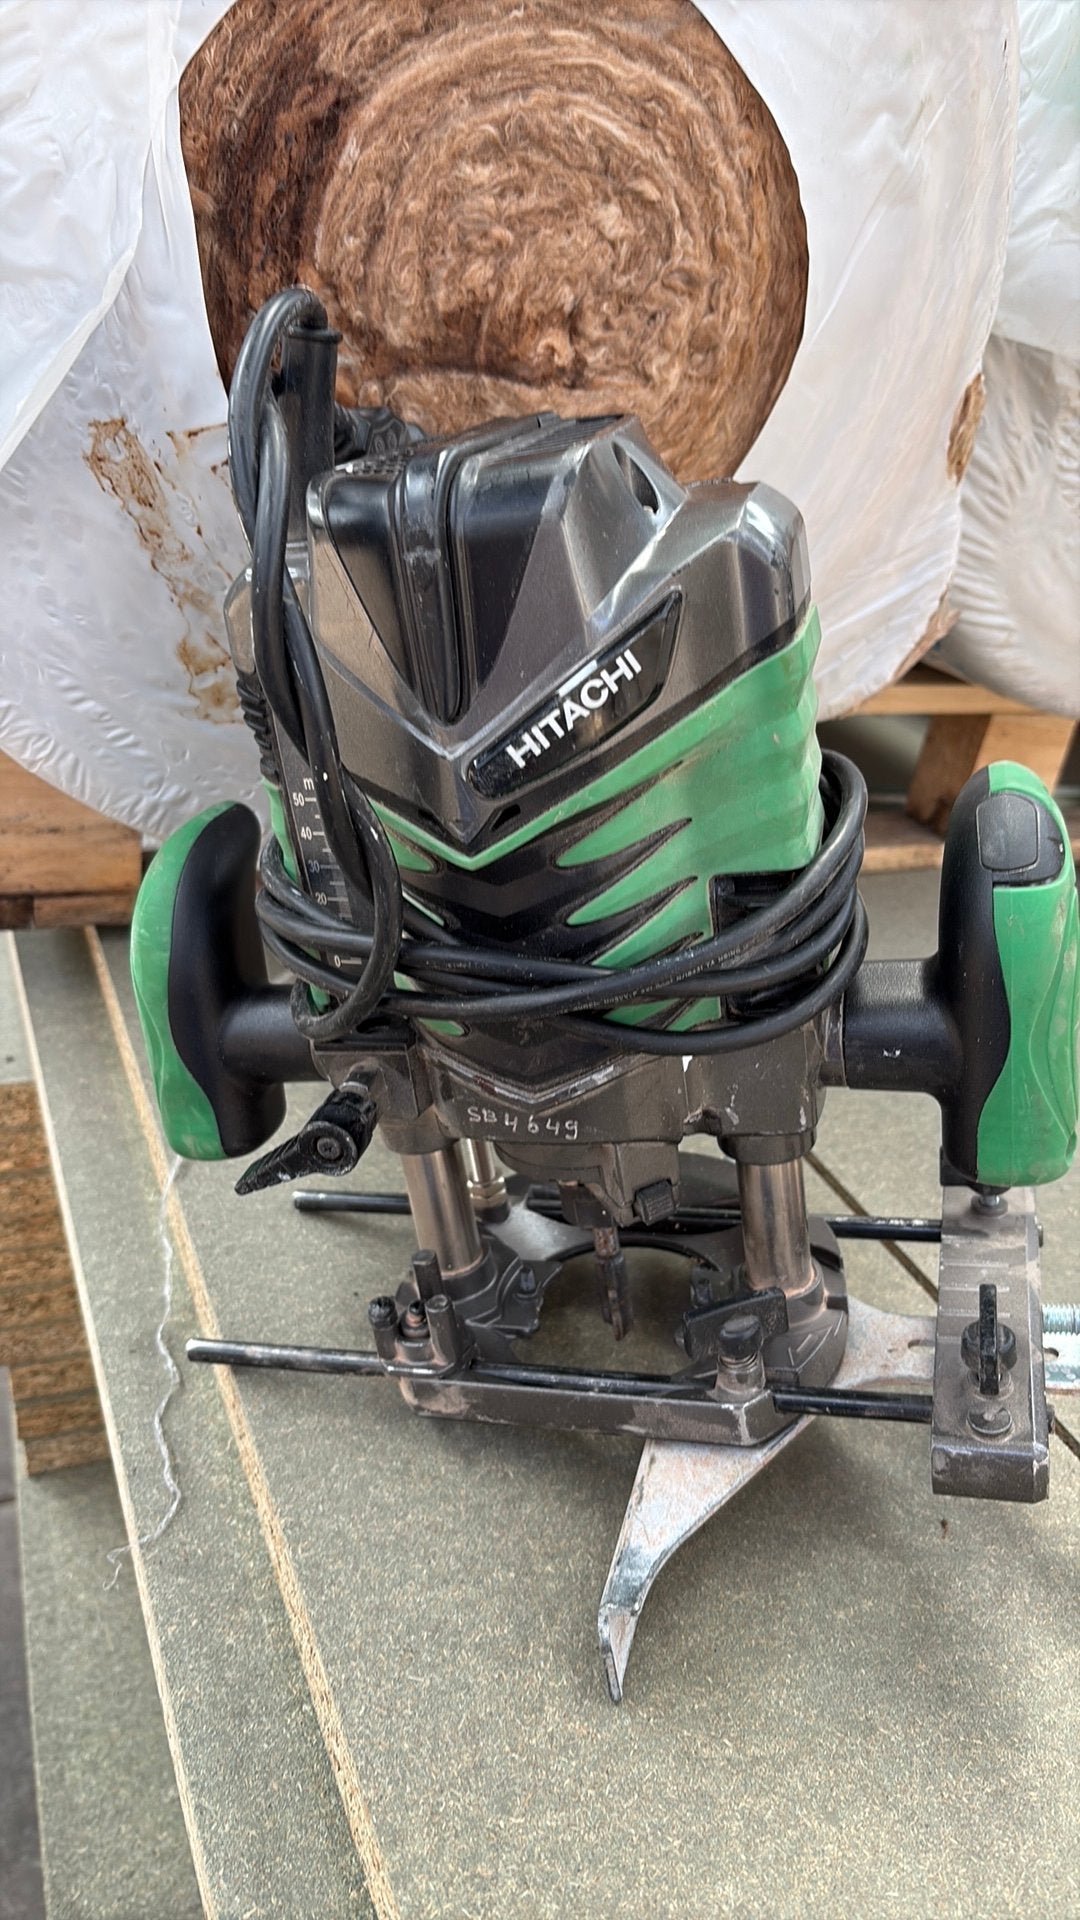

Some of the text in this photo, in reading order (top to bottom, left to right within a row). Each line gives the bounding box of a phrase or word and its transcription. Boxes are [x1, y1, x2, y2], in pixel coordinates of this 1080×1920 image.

[505, 648, 642, 770] HITACHI
[293, 793, 305, 807] 50
[300, 825, 313, 841] 40
[308, 859, 320, 873] 30
[315, 891, 328, 906] 20
[334, 954, 341, 968] 0
